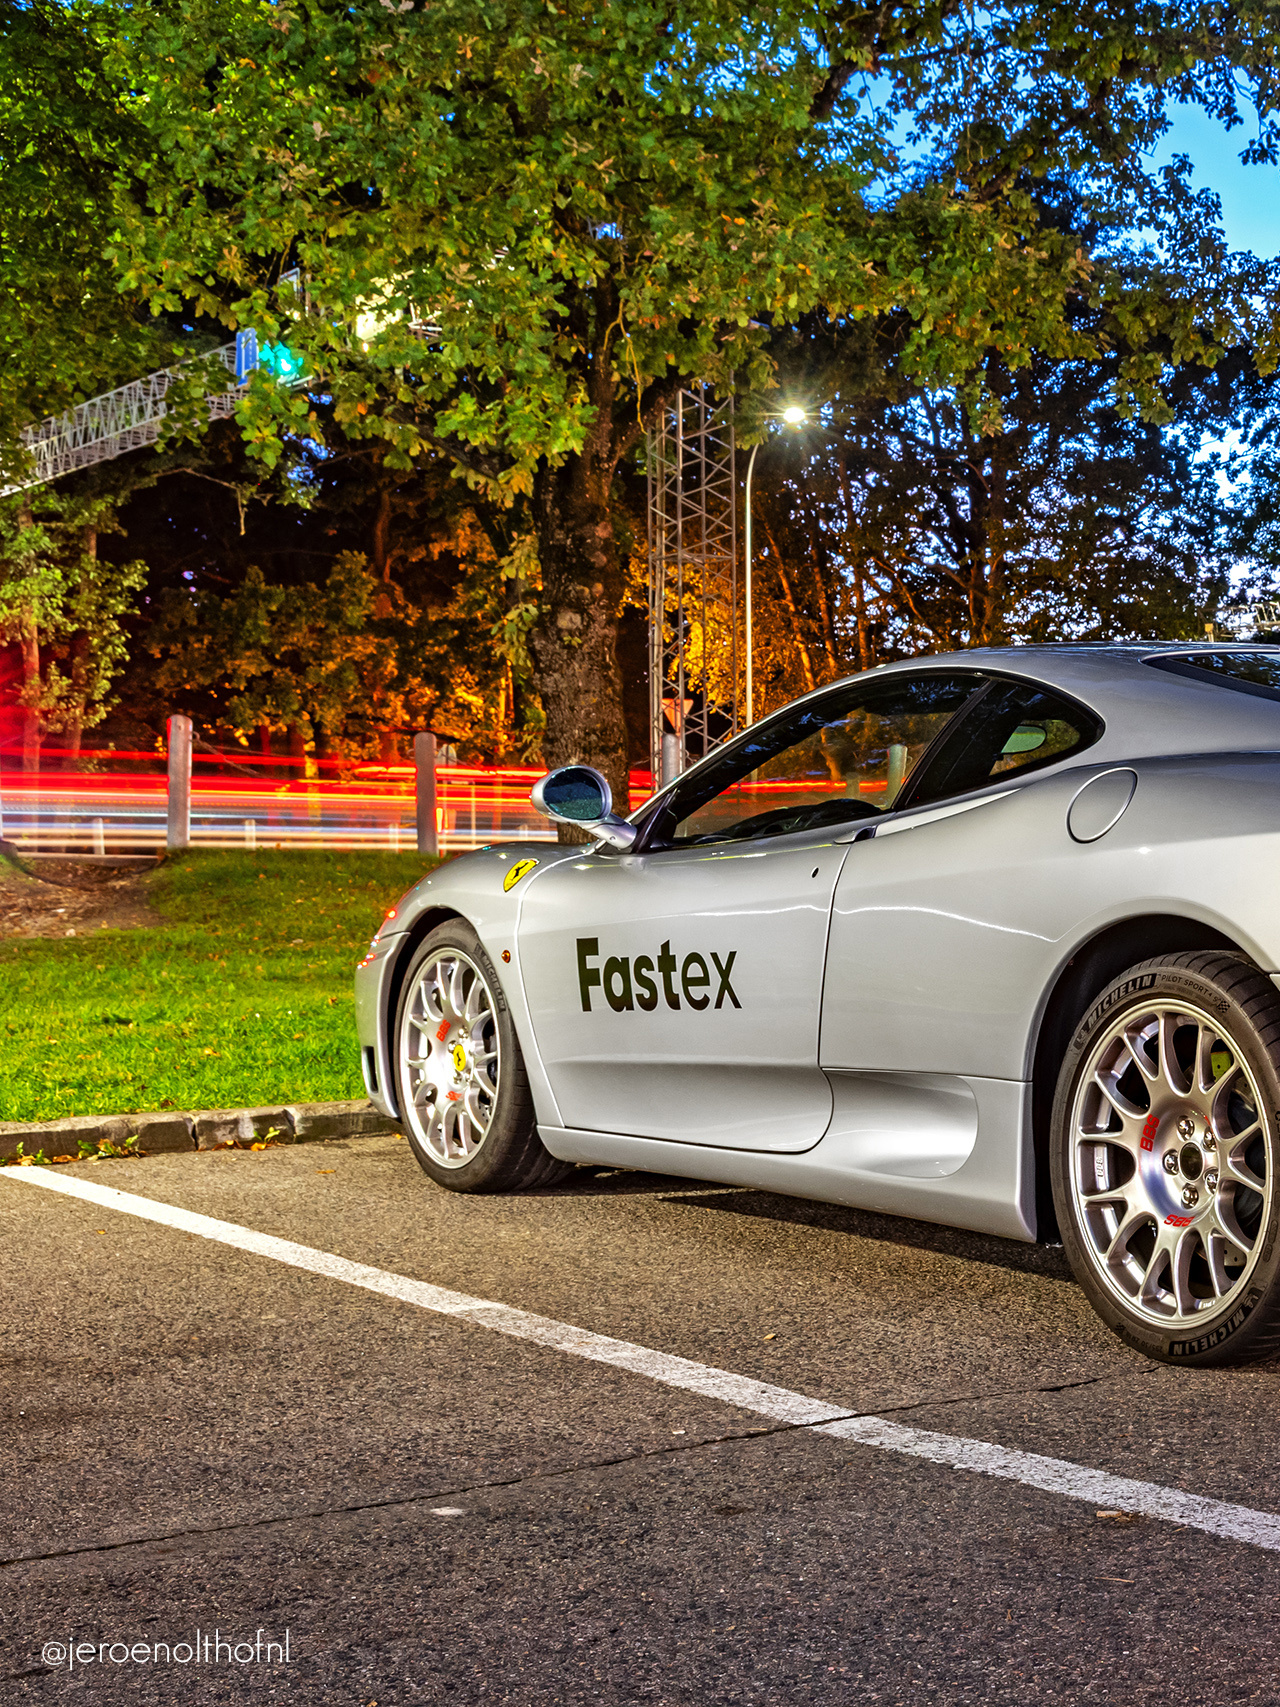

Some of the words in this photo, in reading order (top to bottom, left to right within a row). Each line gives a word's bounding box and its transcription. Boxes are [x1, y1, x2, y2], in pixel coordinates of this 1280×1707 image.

[483, 957, 506, 1011] MICHELIN
[576, 937, 742, 1012] Fastex
[1161, 974, 1182, 984] PILOT
[1184, 979, 1208, 995] SPORT
[1088, 973, 1154, 1028] MICHELIN
[436, 1019, 451, 1042] BBS
[1140, 1114, 1160, 1152] BBS
[1164, 1214, 1195, 1228] BBS
[1173, 1308, 1246, 1355] MICHELIN
